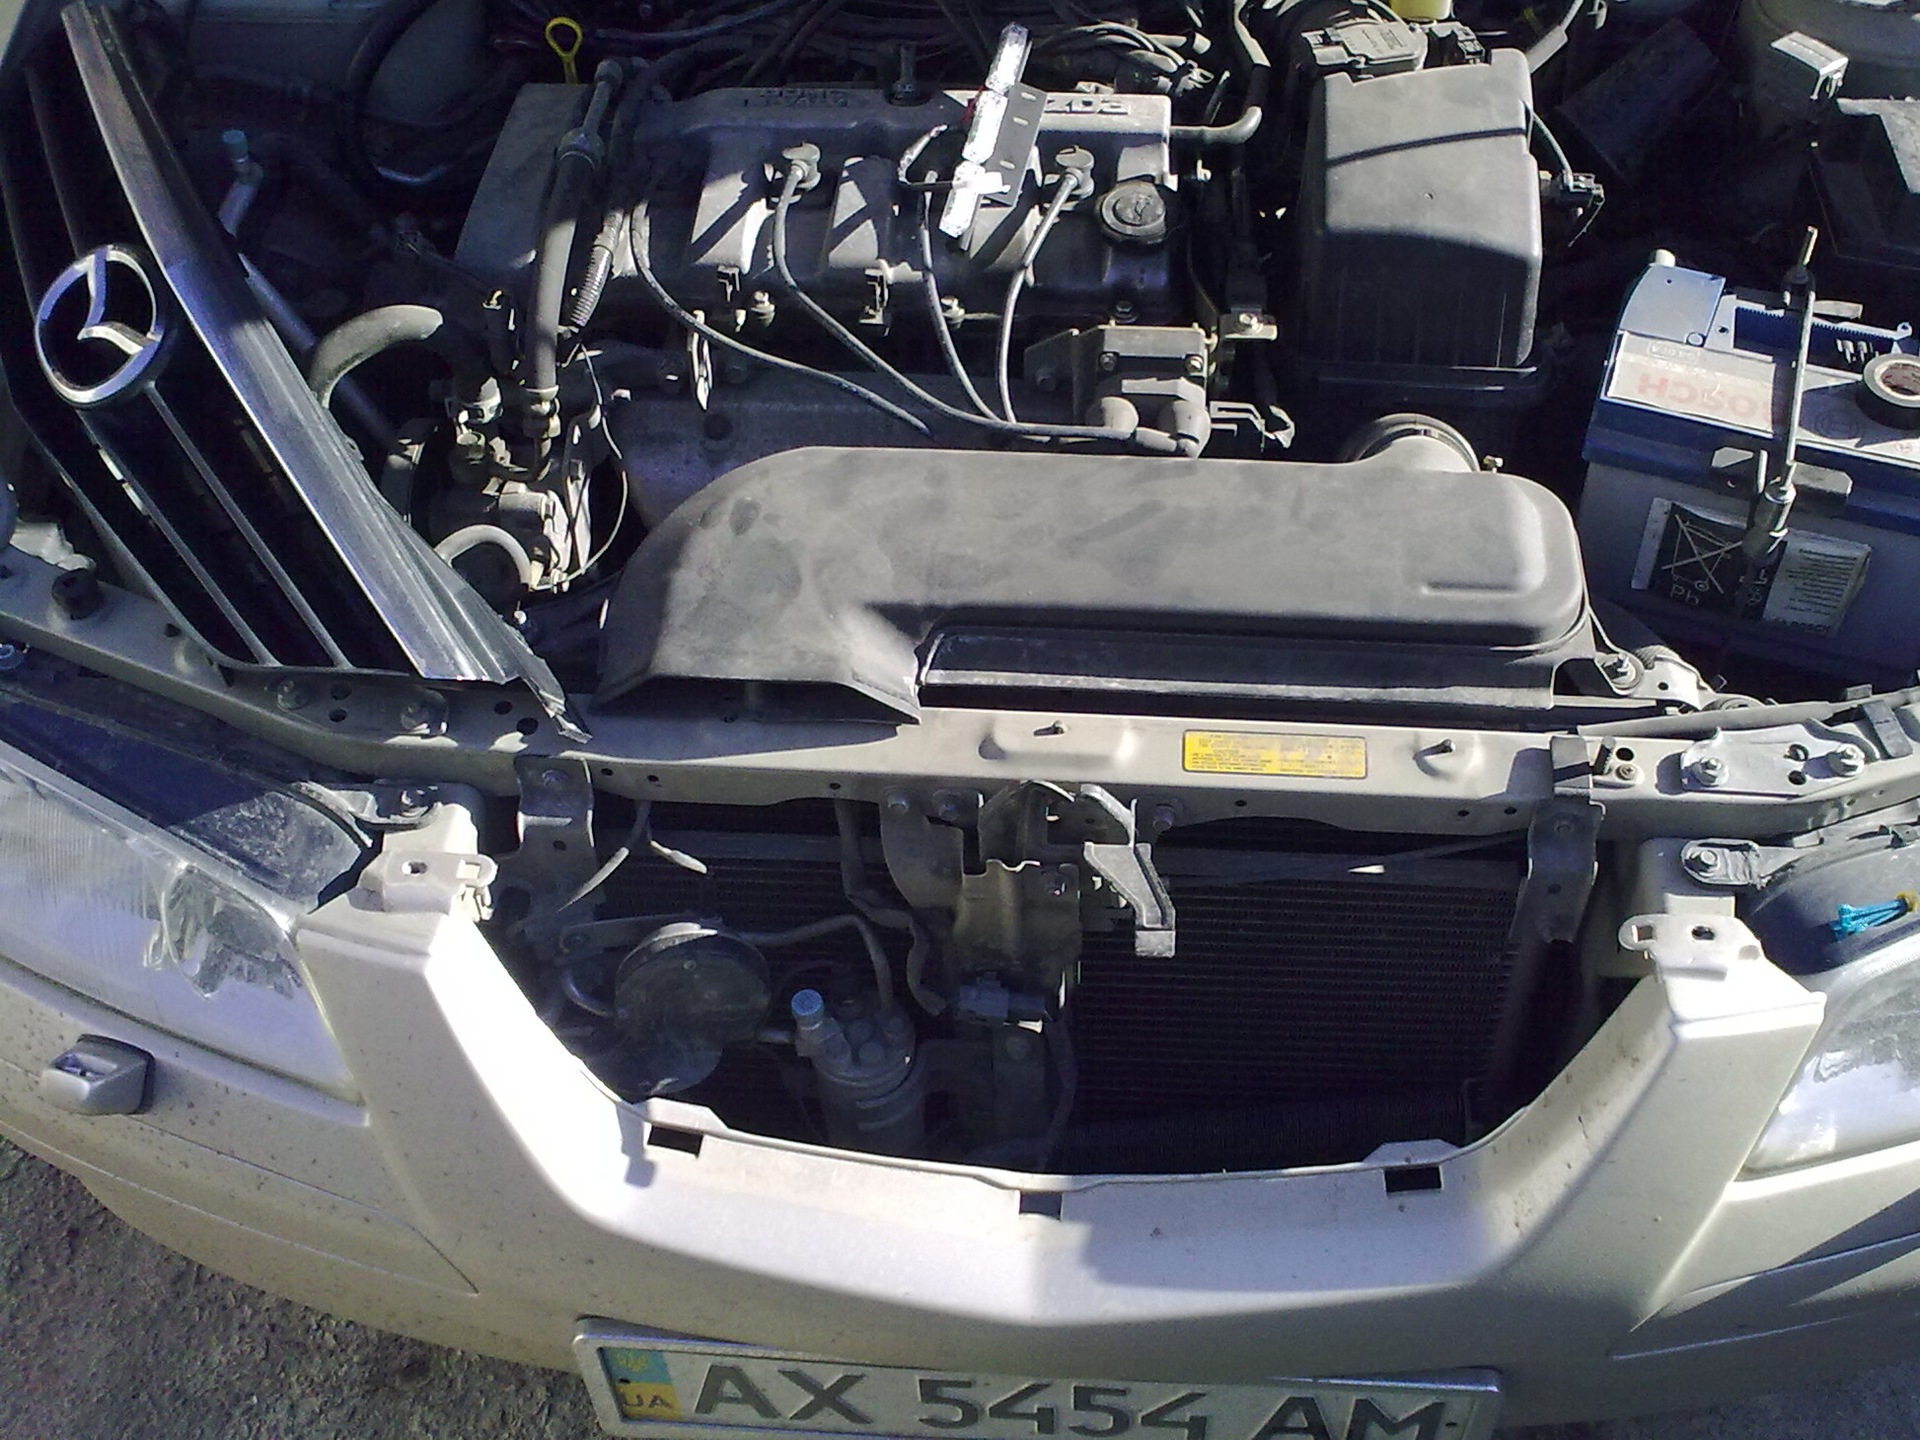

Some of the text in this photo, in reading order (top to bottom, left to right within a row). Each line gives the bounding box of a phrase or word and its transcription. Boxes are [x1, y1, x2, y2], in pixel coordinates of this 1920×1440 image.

[1670, 583, 1699, 606] Pb
[622, 1393, 672, 1410] UA
[694, 1364, 1446, 1439] AX 5454 AM
